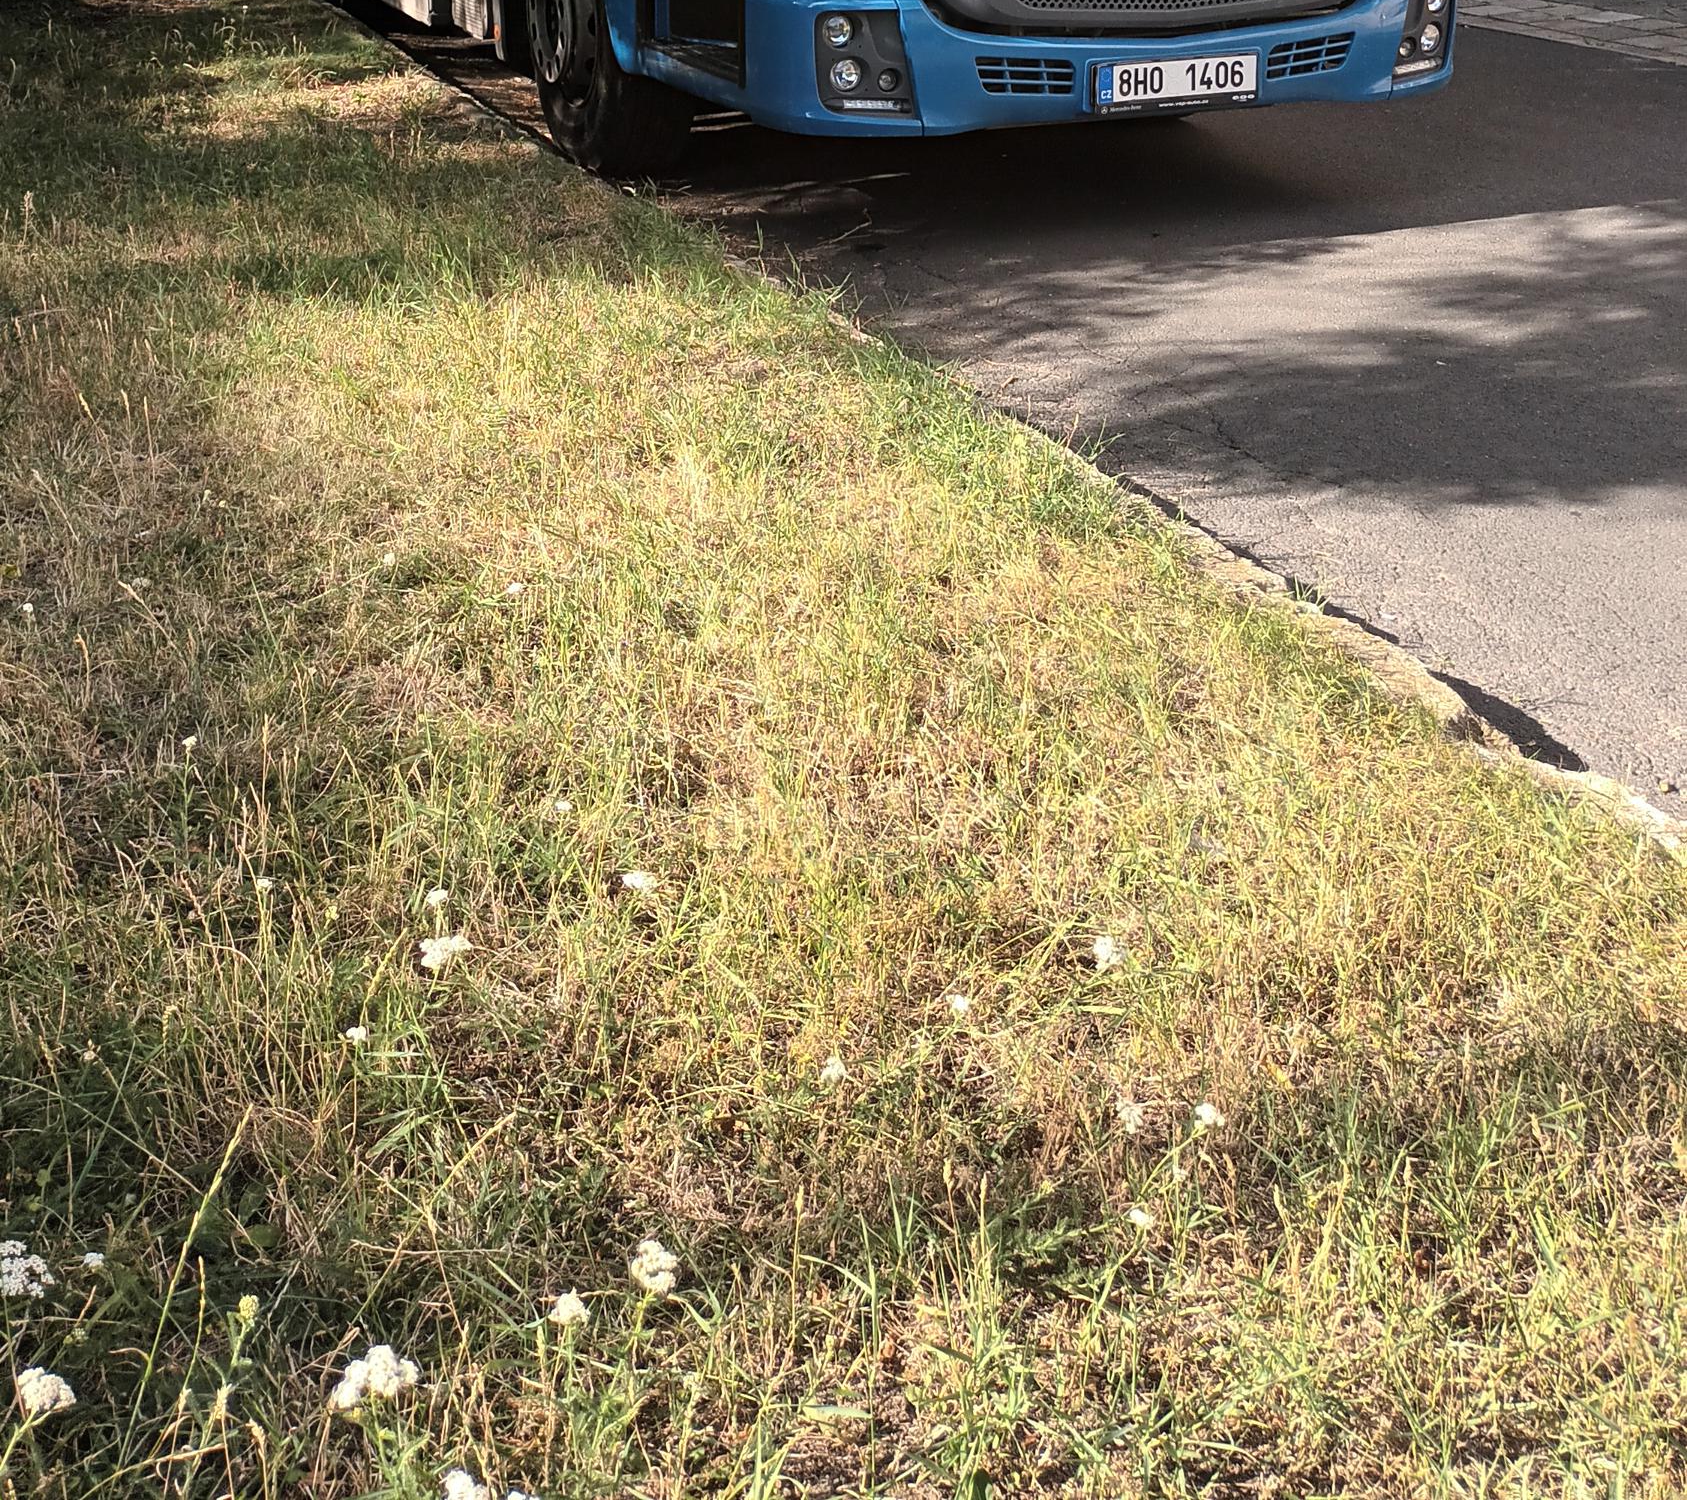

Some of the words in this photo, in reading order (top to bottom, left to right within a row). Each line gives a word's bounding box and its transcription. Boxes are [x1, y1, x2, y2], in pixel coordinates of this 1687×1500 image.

[1118, 66, 1164, 97] 8H0
[1185, 60, 1245, 91] 1406
[1101, 90, 1112, 100] CZ
